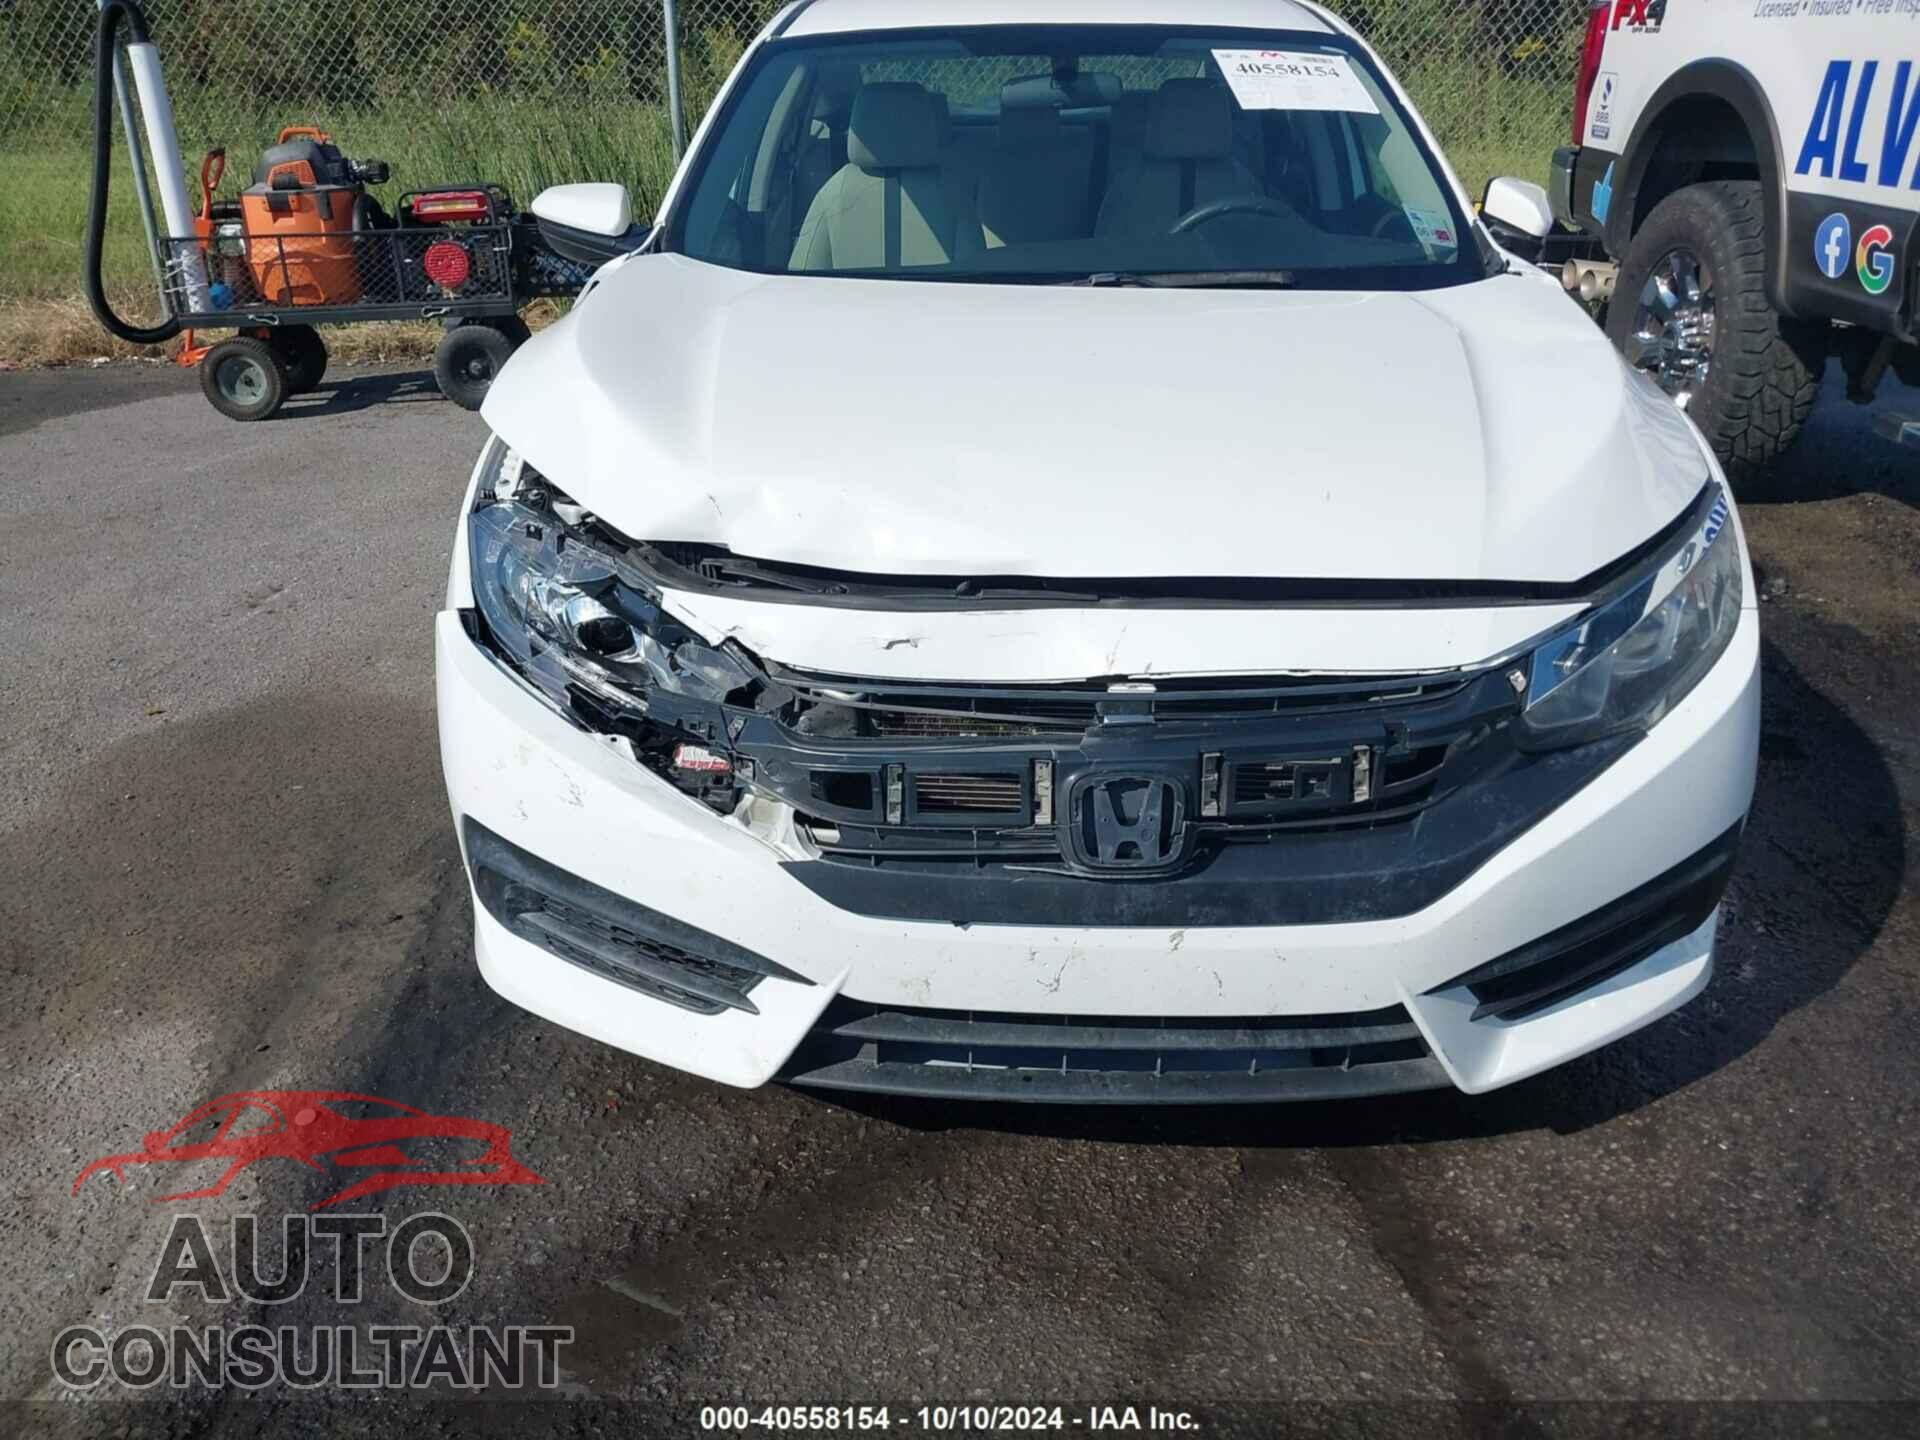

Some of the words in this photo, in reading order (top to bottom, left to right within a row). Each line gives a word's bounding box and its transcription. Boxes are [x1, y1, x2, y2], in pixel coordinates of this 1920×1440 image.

[1611, 0, 1667, 31] FX4
[1753, 0, 1800, 18] Licensed
[1808, 0, 1850, 16] Insured
[1236, 62, 1340, 78] 40558154
[1794, 60, 1920, 191] ALV
